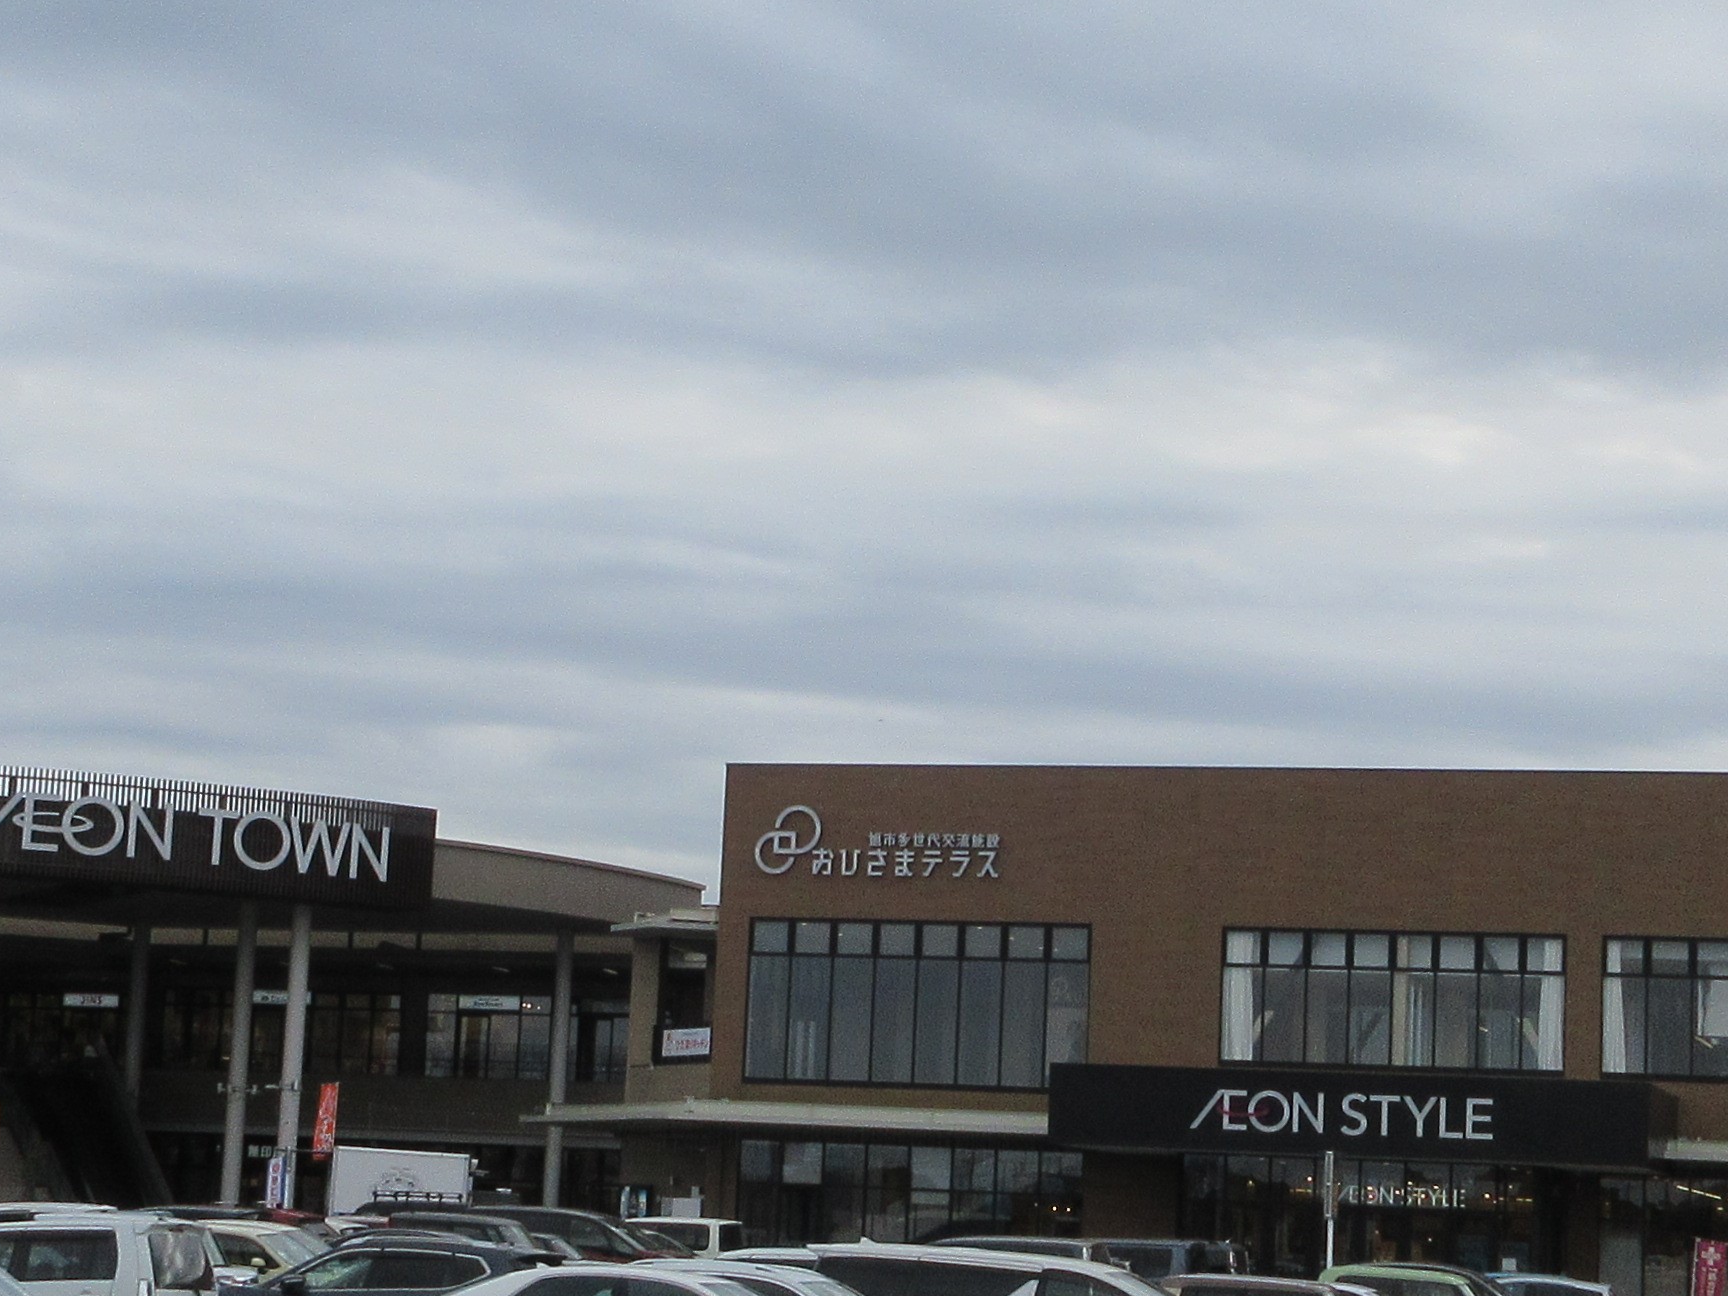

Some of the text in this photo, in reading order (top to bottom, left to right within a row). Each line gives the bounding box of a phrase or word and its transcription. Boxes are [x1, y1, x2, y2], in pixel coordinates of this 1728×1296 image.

[198, 807, 391, 882] TOWN
[811, 848, 999, 878] おひさまテラス
[1340, 1092, 1494, 1141] STYLE
